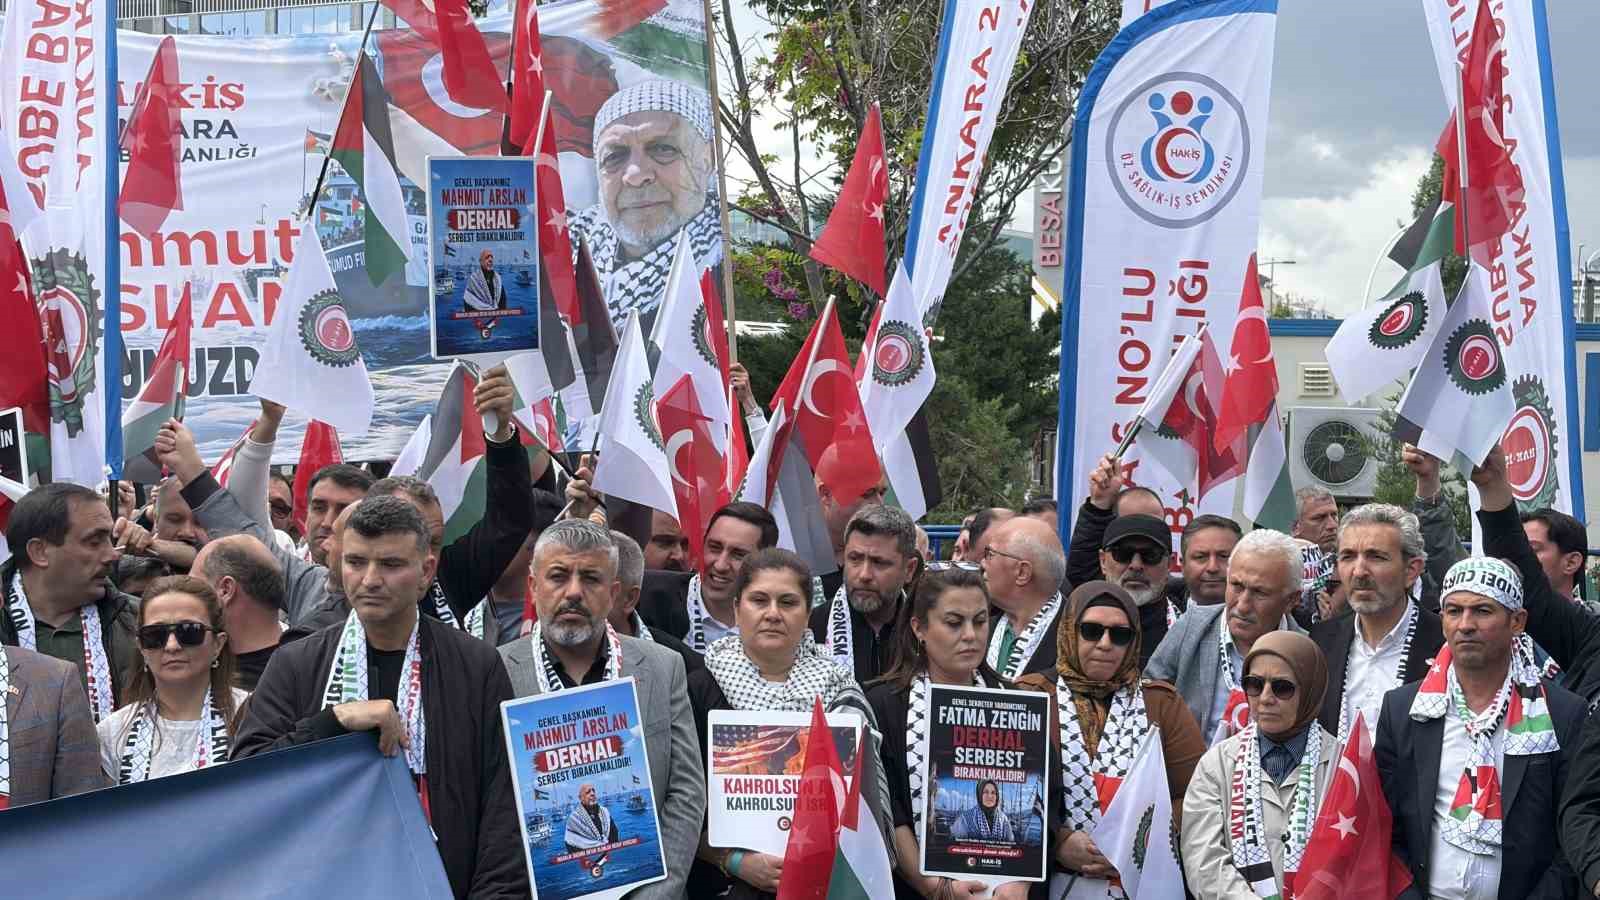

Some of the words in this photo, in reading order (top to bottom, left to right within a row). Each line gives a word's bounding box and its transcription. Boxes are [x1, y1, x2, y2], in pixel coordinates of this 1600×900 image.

[442, 188, 485, 206] MAHMUT
[488, 188, 526, 206] ARSLAN
[457, 209, 514, 230] DERHAL
[448, 232, 474, 242] SERBEST
[938, 706, 986, 727] FATMA
[990, 710, 1040, 731] ZENGİN
[524, 724, 577, 751] MAHMUT
[582, 712, 628, 738] ARSLAN
[952, 726, 1025, 750] DERHAL
[545, 738, 618, 770] DERHAL
[954, 747, 1025, 768] SERBEST
[537, 771, 570, 787] SERBEST
[571, 756, 632, 779] BIRAKILMALIDIR!
[954, 766, 1025, 782] BIRAKILMALIDIR!
